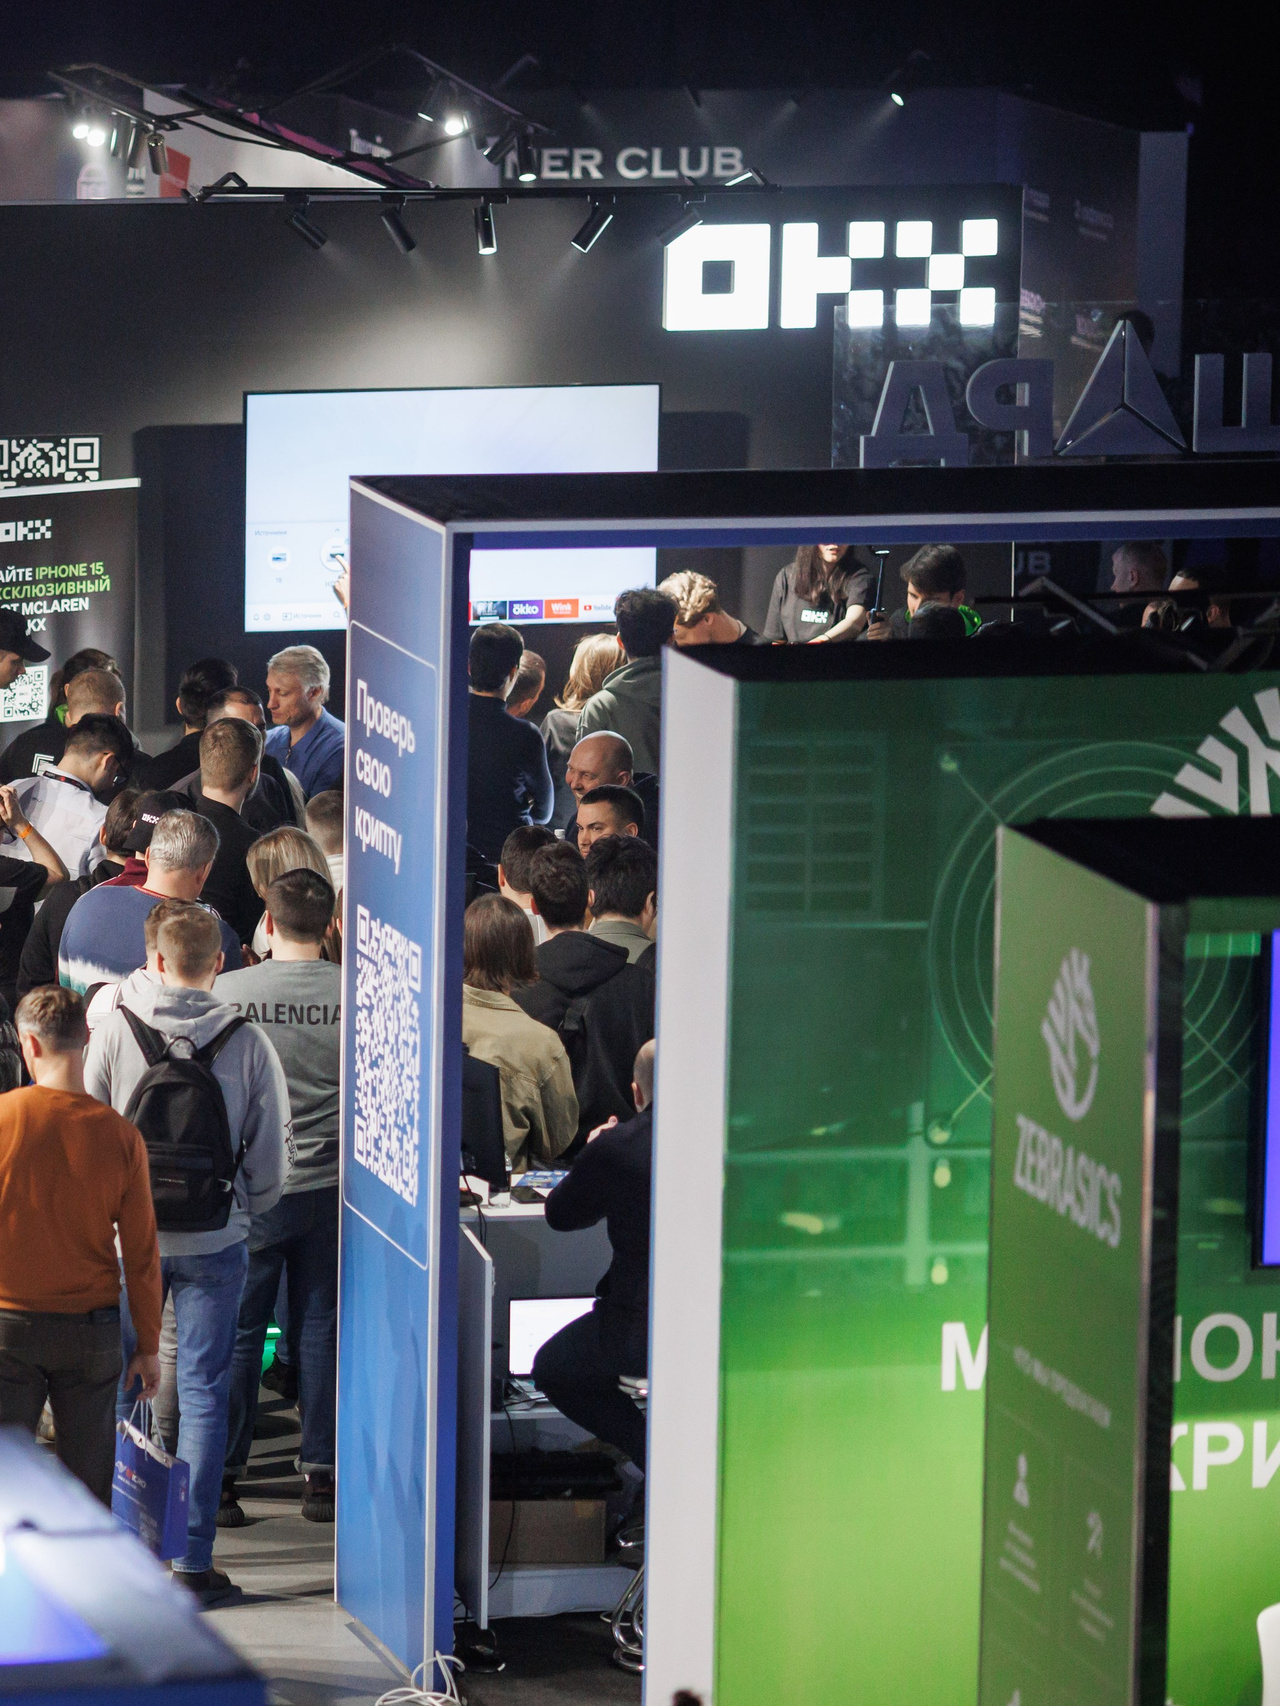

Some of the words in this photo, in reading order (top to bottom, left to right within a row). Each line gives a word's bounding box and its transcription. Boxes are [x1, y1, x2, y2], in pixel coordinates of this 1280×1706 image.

[615, 146, 743, 180] CLUB
[663, 218, 998, 331] OKX
[0, 519, 52, 543] OKX
[35, 563, 88, 580] IPHONE
[89, 561, 104, 575] 15
[22, 597, 90, 615] MCLAREN
[356, 678, 416, 757] Проверь
[356, 748, 391, 798] свою
[355, 805, 402, 875] крипту
[1013, 1112, 1122, 1248] ZEBRASICS
